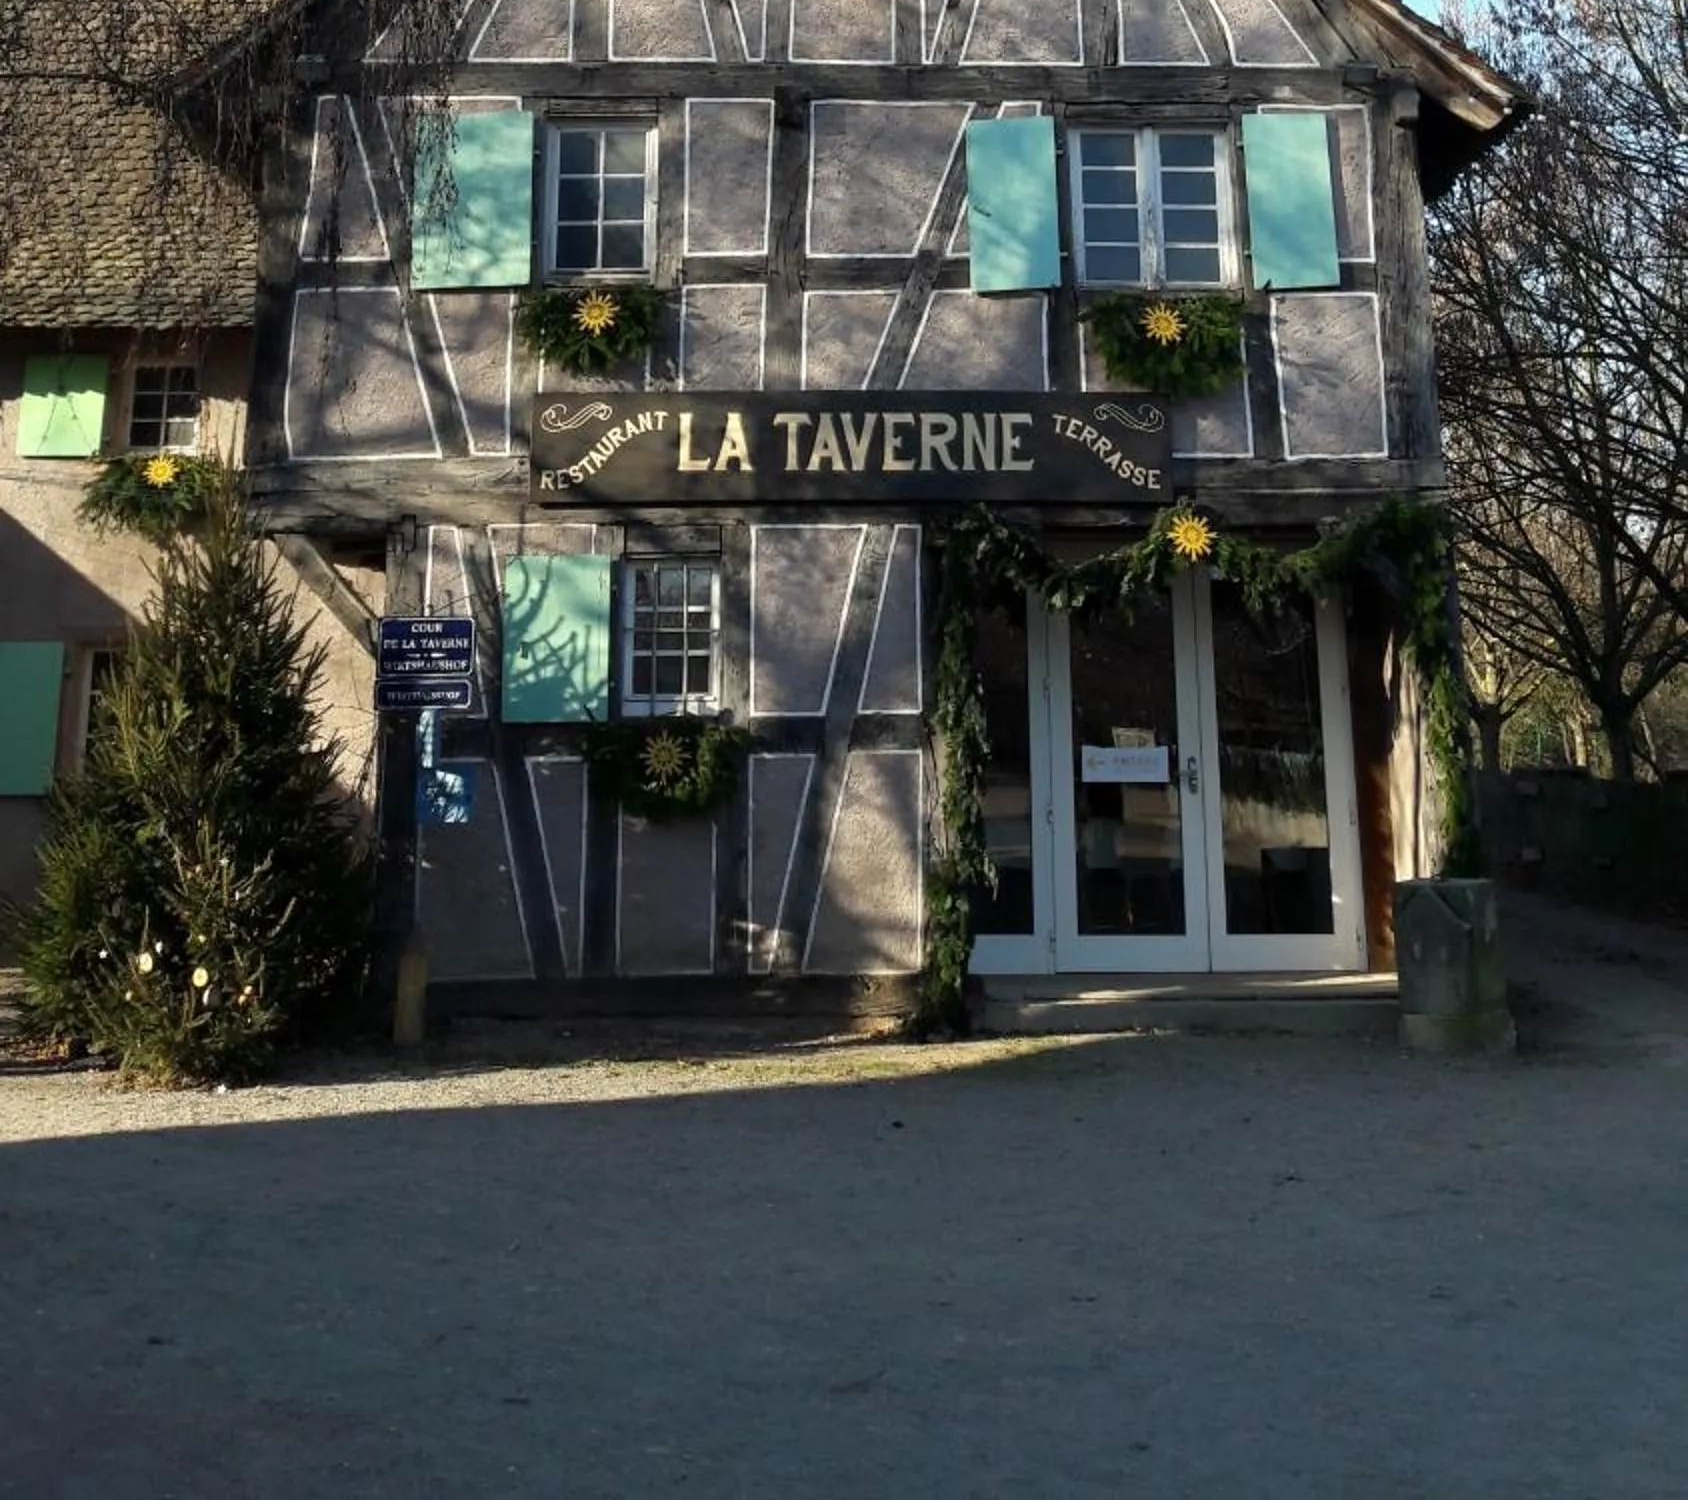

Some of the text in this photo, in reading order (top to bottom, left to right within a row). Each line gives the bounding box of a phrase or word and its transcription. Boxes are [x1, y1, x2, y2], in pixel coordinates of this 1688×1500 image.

[541, 410, 668, 490] RESTAURANT
[677, 411, 1034, 472] LA TAVERNE
[1052, 413, 1161, 490] TERRASSE
[383, 637, 469, 649] DE LA TAVERNE
[411, 623, 443, 633] COUR
